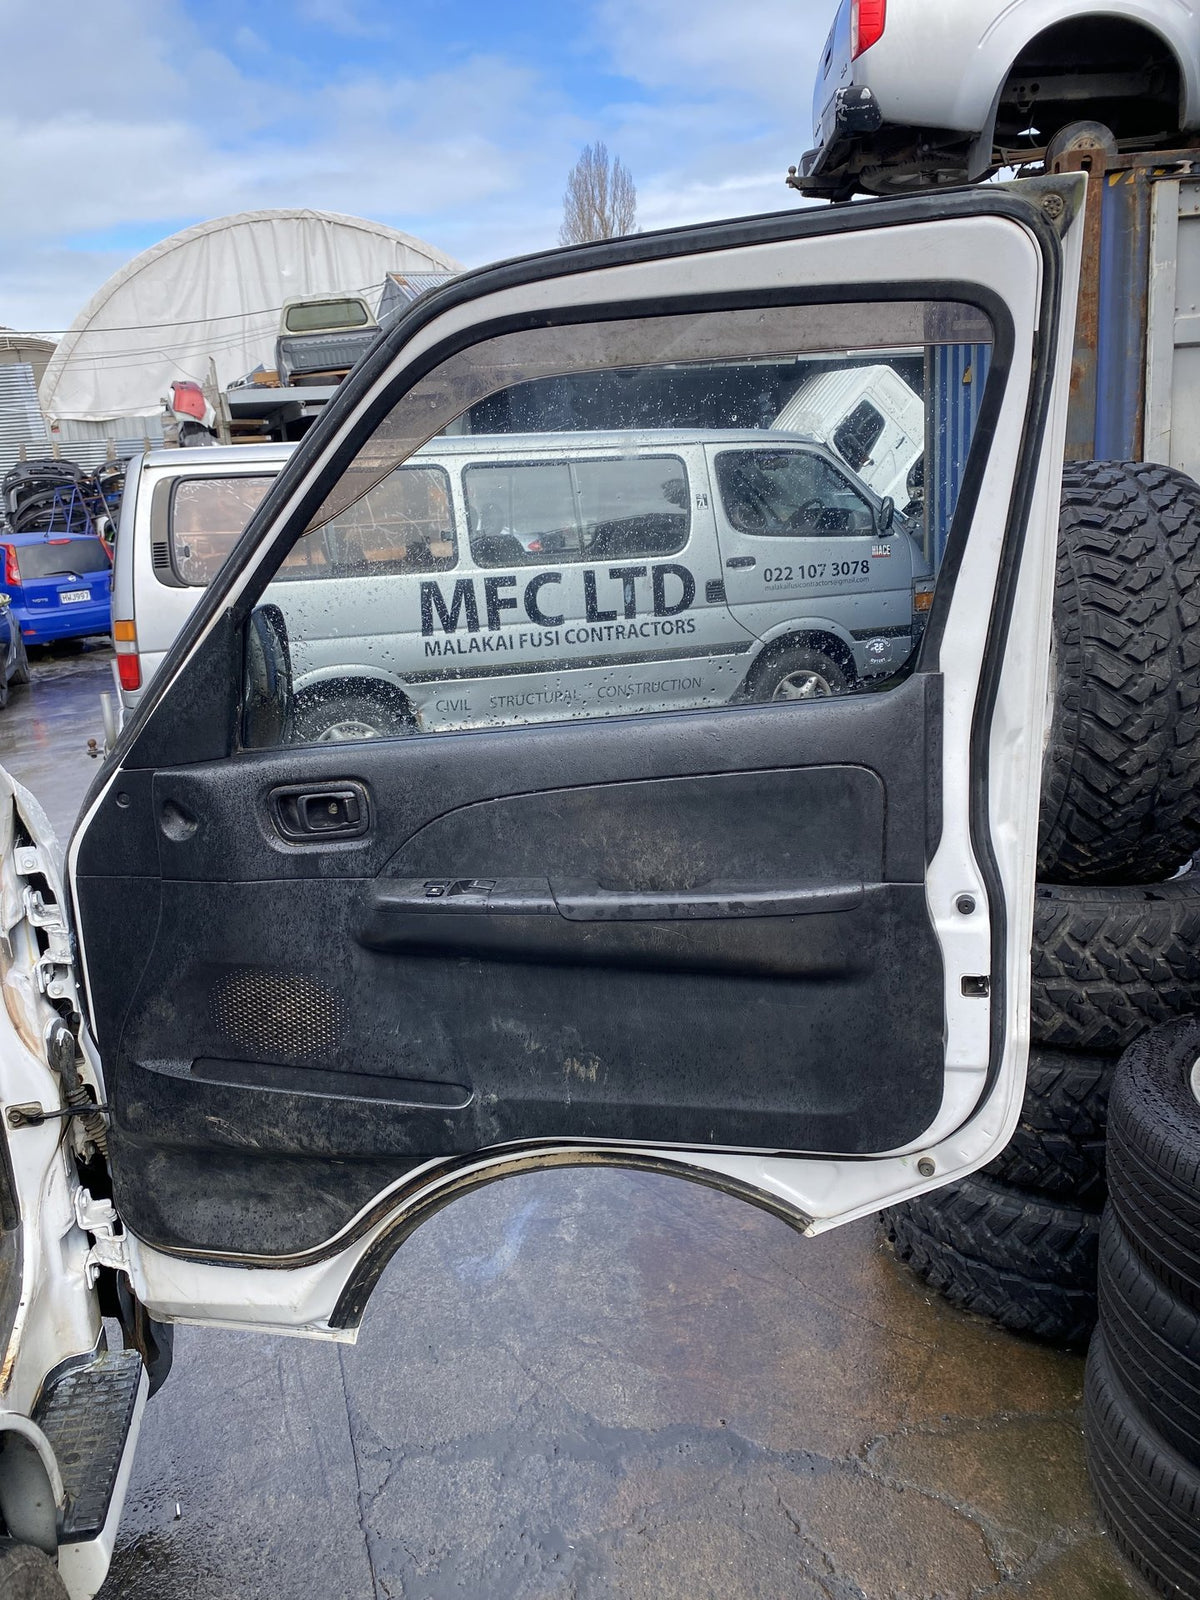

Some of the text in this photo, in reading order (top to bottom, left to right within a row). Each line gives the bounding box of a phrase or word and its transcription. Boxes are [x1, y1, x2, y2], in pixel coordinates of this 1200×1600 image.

[763, 559, 870, 582] 022 107 3078
[420, 563, 697, 637] MFC LTD
[424, 618, 696, 657] MALAKAI FUSI CONTRACTORS
[435, 676, 703, 713] CIVIL STRUCTURAL CONSTRUCTION
